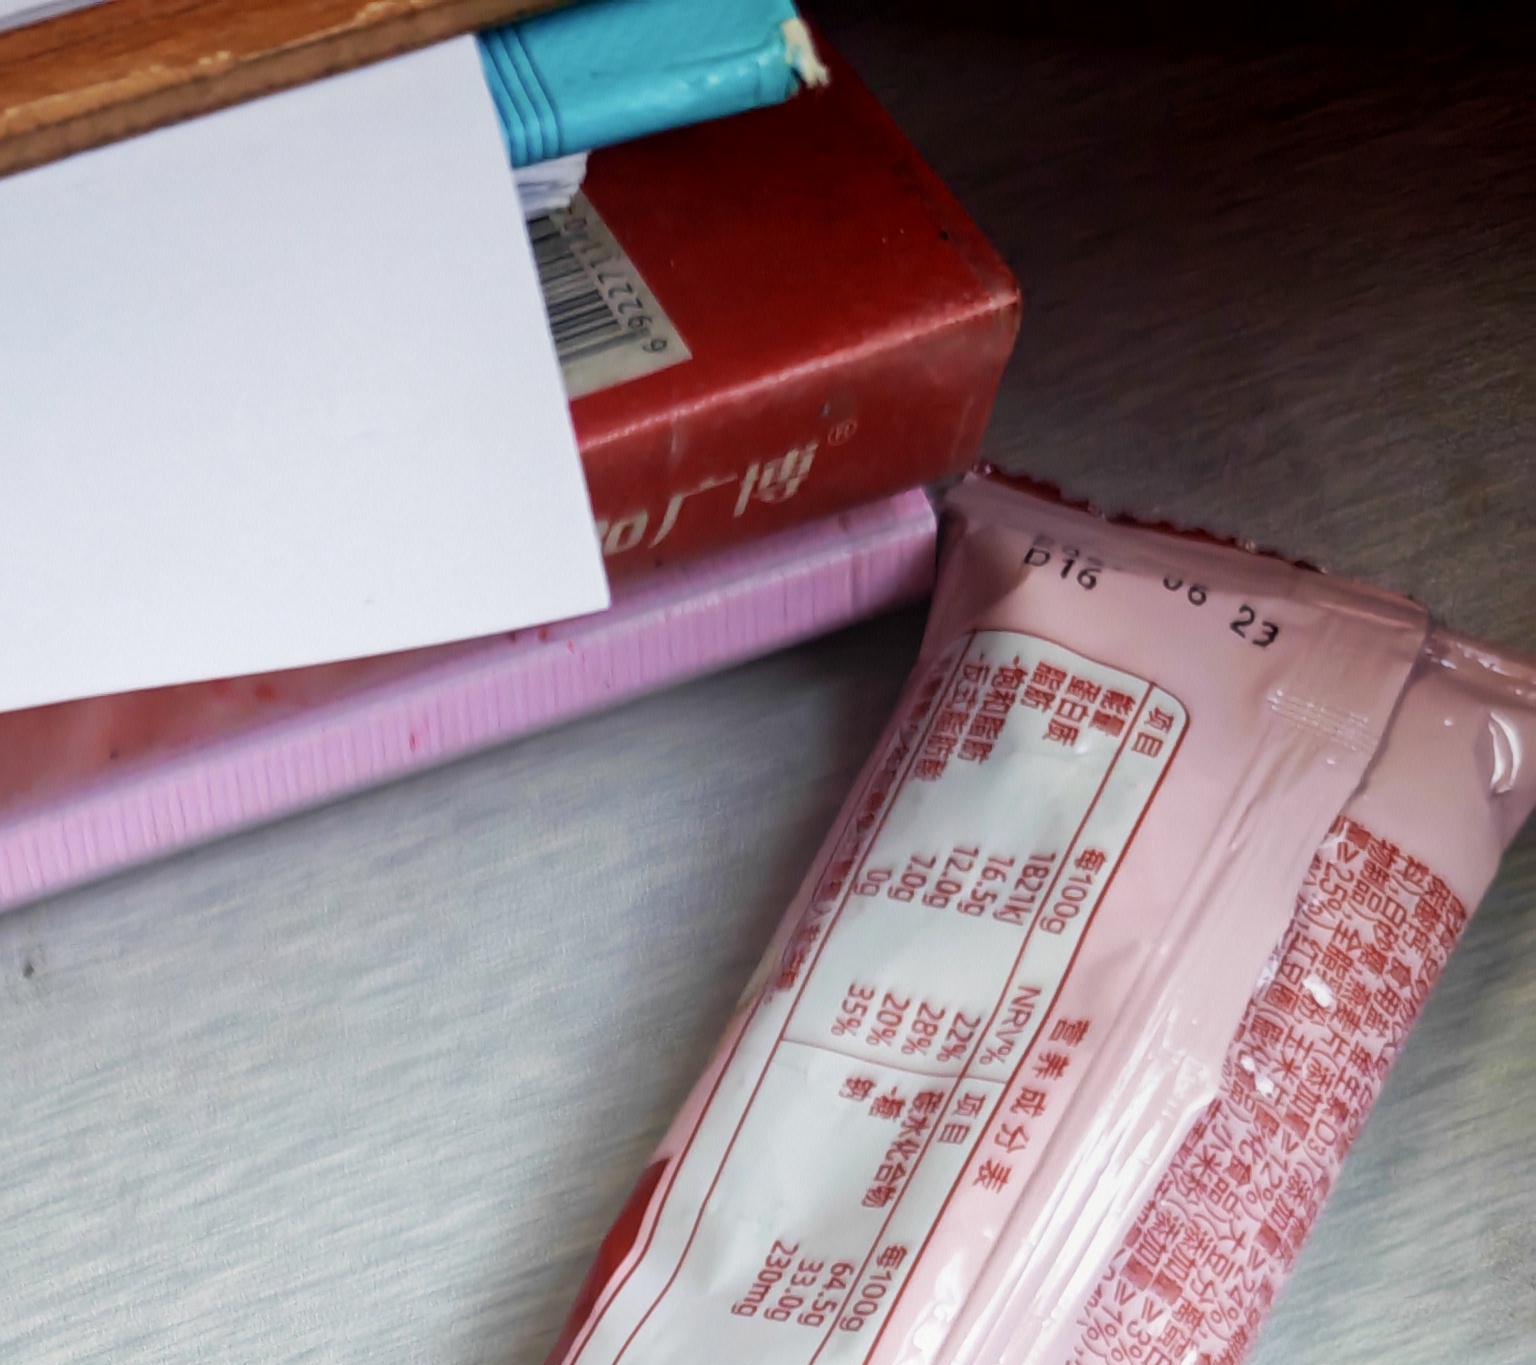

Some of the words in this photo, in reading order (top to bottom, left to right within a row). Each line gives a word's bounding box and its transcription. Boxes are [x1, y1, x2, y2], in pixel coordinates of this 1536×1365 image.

[1230, 604, 1278, 647] 23
[1017, 657, 1068, 716] 脂肪
[1040, 671, 1103, 753] 蛋白质
[1128, 702, 1178, 763] 项目
[850, 858, 894, 905] 0g
[884, 844, 938, 910] 7.0g
[919, 835, 981, 918] 12.0g
[954, 844, 1017, 925] 16.5g
[1036, 841, 1108, 942] 每100g
[826, 978, 877, 1042] 35%
[860, 988, 911, 1052] 20%
[896, 998, 946, 1062] 28%
[931, 1006, 982, 1070] 22%
[975, 977, 1043, 1074] NRV%
[934, 1084, 988, 1153] 项目
[970, 1007, 1092, 1199] 营养成分表
[729, 1230, 800, 1327] 230mg
[762, 1249, 824, 1331] 33.0g
[795, 1253, 856, 1336] 64.5g
[836, 1235, 909, 1340] 每100g
